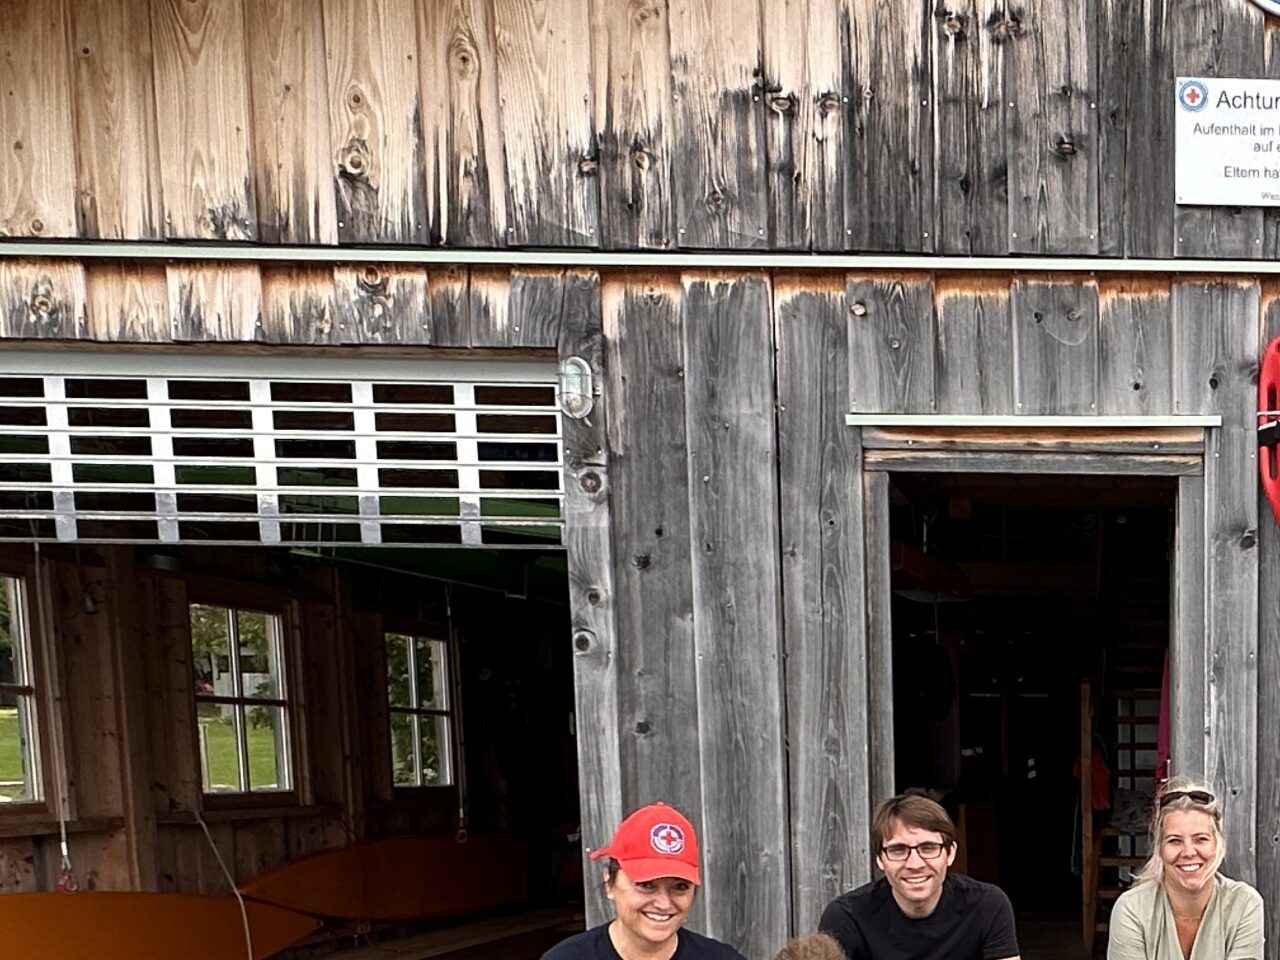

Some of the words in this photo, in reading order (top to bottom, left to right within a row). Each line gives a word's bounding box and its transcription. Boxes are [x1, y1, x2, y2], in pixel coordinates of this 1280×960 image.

[1193, 122, 1256, 136] Aufenthalt
[1260, 124, 1274, 136] im
[1253, 140, 1273, 152] auf
[1224, 165, 1260, 178] Eltern
